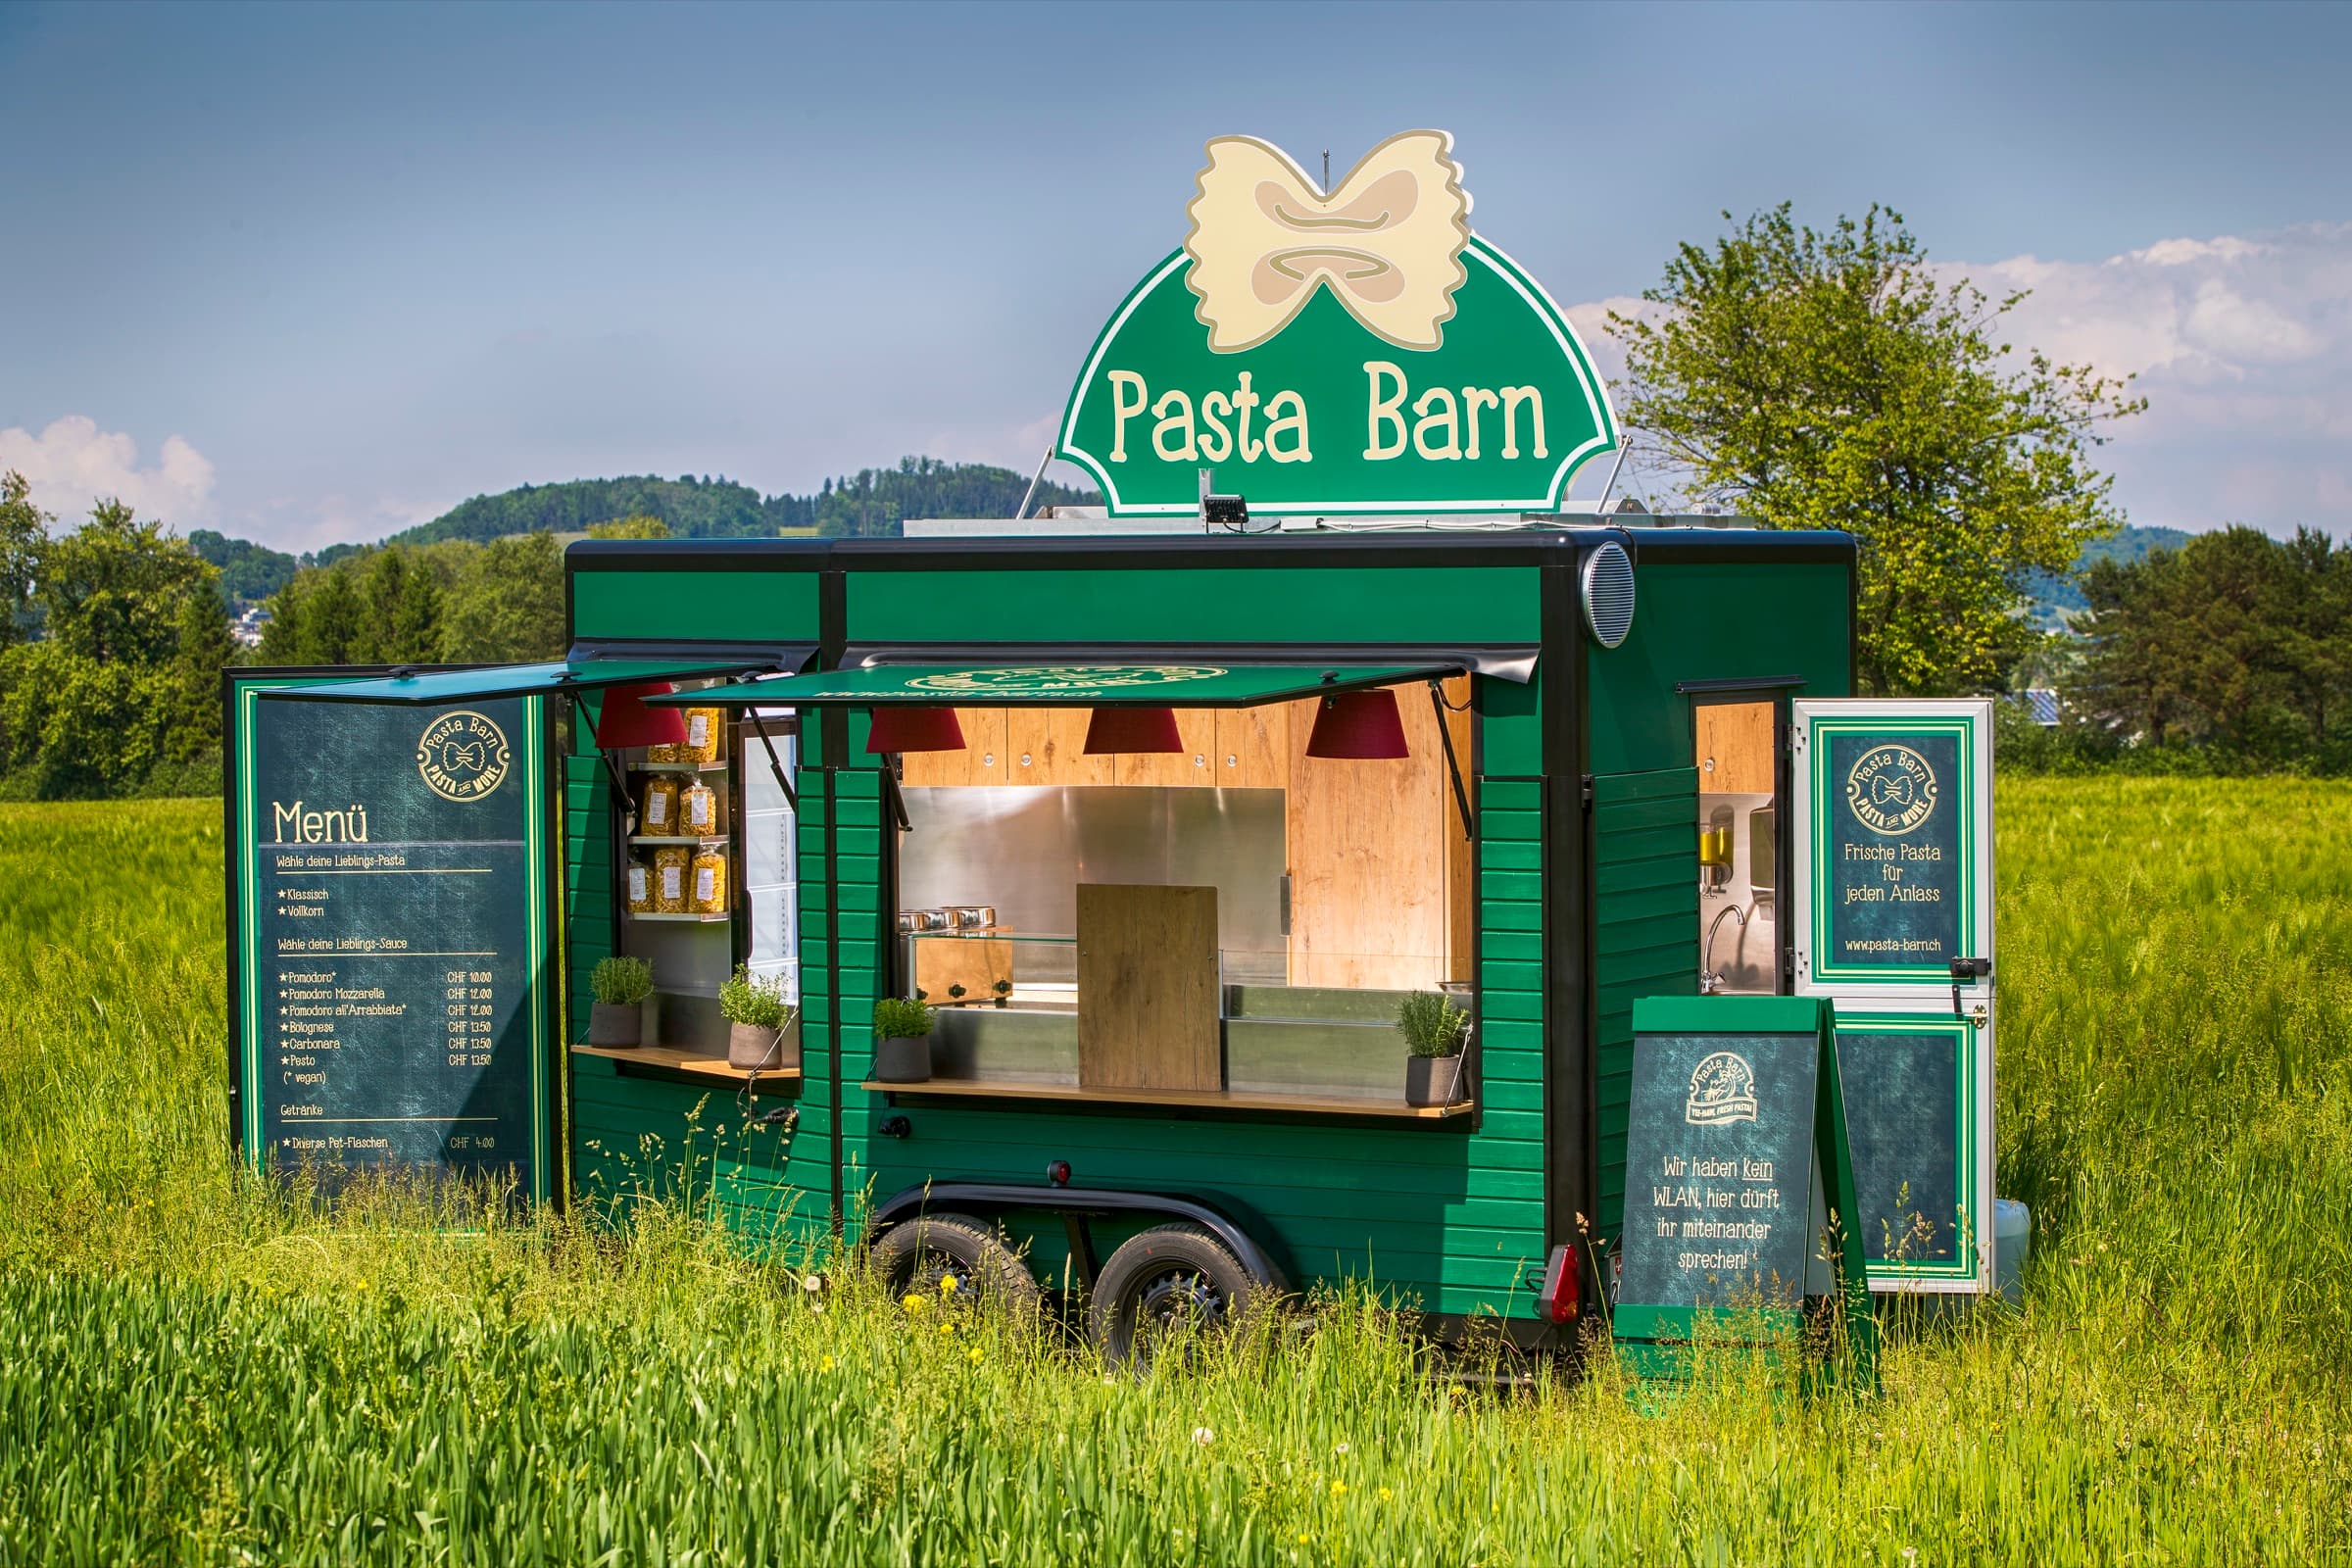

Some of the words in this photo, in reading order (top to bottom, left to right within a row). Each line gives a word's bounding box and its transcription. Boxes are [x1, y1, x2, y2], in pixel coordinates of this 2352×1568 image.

[1106, 368, 1313, 464] Pasta
[1362, 361, 1549, 461] Barn
[426, 719, 463, 750] Pasta
[469, 716, 499, 749] Barn
[1855, 754, 1892, 783] Pasta
[1897, 752, 1927, 783] Barn
[426, 764, 457, 794] PASTA
[458, 783, 471, 793] AND
[472, 764, 501, 793] MORE
[1856, 798, 1886, 827] PASTA
[1886, 816, 1899, 827] AND
[1900, 799, 1929, 826] MORE
[272, 800, 368, 844] Menü
[1844, 844, 1894, 860] Frische
[1900, 844, 1940, 860] Pasta
[275, 855, 304, 867] Wähle
[306, 855, 331, 867] deine
[335, 855, 406, 869] Lieblings-Pasta
[1882, 863, 1904, 881] für
[287, 889, 329, 901] Klassisch
[1844, 885, 1885, 905] jeden
[1889, 884, 1940, 902] Anlass
[287, 906, 324, 917] Vollkorn
[277, 938, 306, 951] Wähle
[308, 938, 333, 950] deine
[336, 938, 408, 952] Lieblings-Sauce
[1845, 938, 1941, 954] www.pasta-barn.ch
[447, 971, 466, 983] CHF
[469, 971, 492, 983] 10.00
[288, 988, 333, 1000] Pomodoro
[335, 988, 385, 1000] Mozzarella
[447, 988, 466, 1000] CHF
[470, 988, 493, 1000] 12.00
[289, 1004, 333, 1016] Pomodoro
[447, 1004, 466, 1016] CHF
[470, 1004, 493, 1016] 12.00
[290, 1021, 334, 1035] Bolognese
[448, 1021, 466, 1033] CHF
[290, 1038, 340, 1050] Carbonara
[449, 1038, 466, 1050] CHF
[290, 1054, 316, 1066] Pesto
[449, 1054, 466, 1066] CHF
[295, 1070, 327, 1085] vegan)
[1696, 1059, 1723, 1083] Pasta
[1726, 1056, 1745, 1082] Barn
[280, 1103, 323, 1116] Getränke
[292, 1137, 326, 1150] Diverse
[329, 1137, 388, 1149] Pet-Flaschen
[450, 1137, 469, 1149] CHF
[475, 1137, 495, 1149] 4.00
[1663, 1156, 1687, 1177] Wir
[1691, 1156, 1738, 1177] haben
[1653, 1187, 1702, 1209] WLAN,
[1706, 1188, 1736, 1207] hier
[1740, 1188, 1780, 1208] dürft
[1657, 1219, 1678, 1238] ihr
[1683, 1220, 1772, 1240] miteinander
[1678, 1250, 1748, 1273] sprechen!
